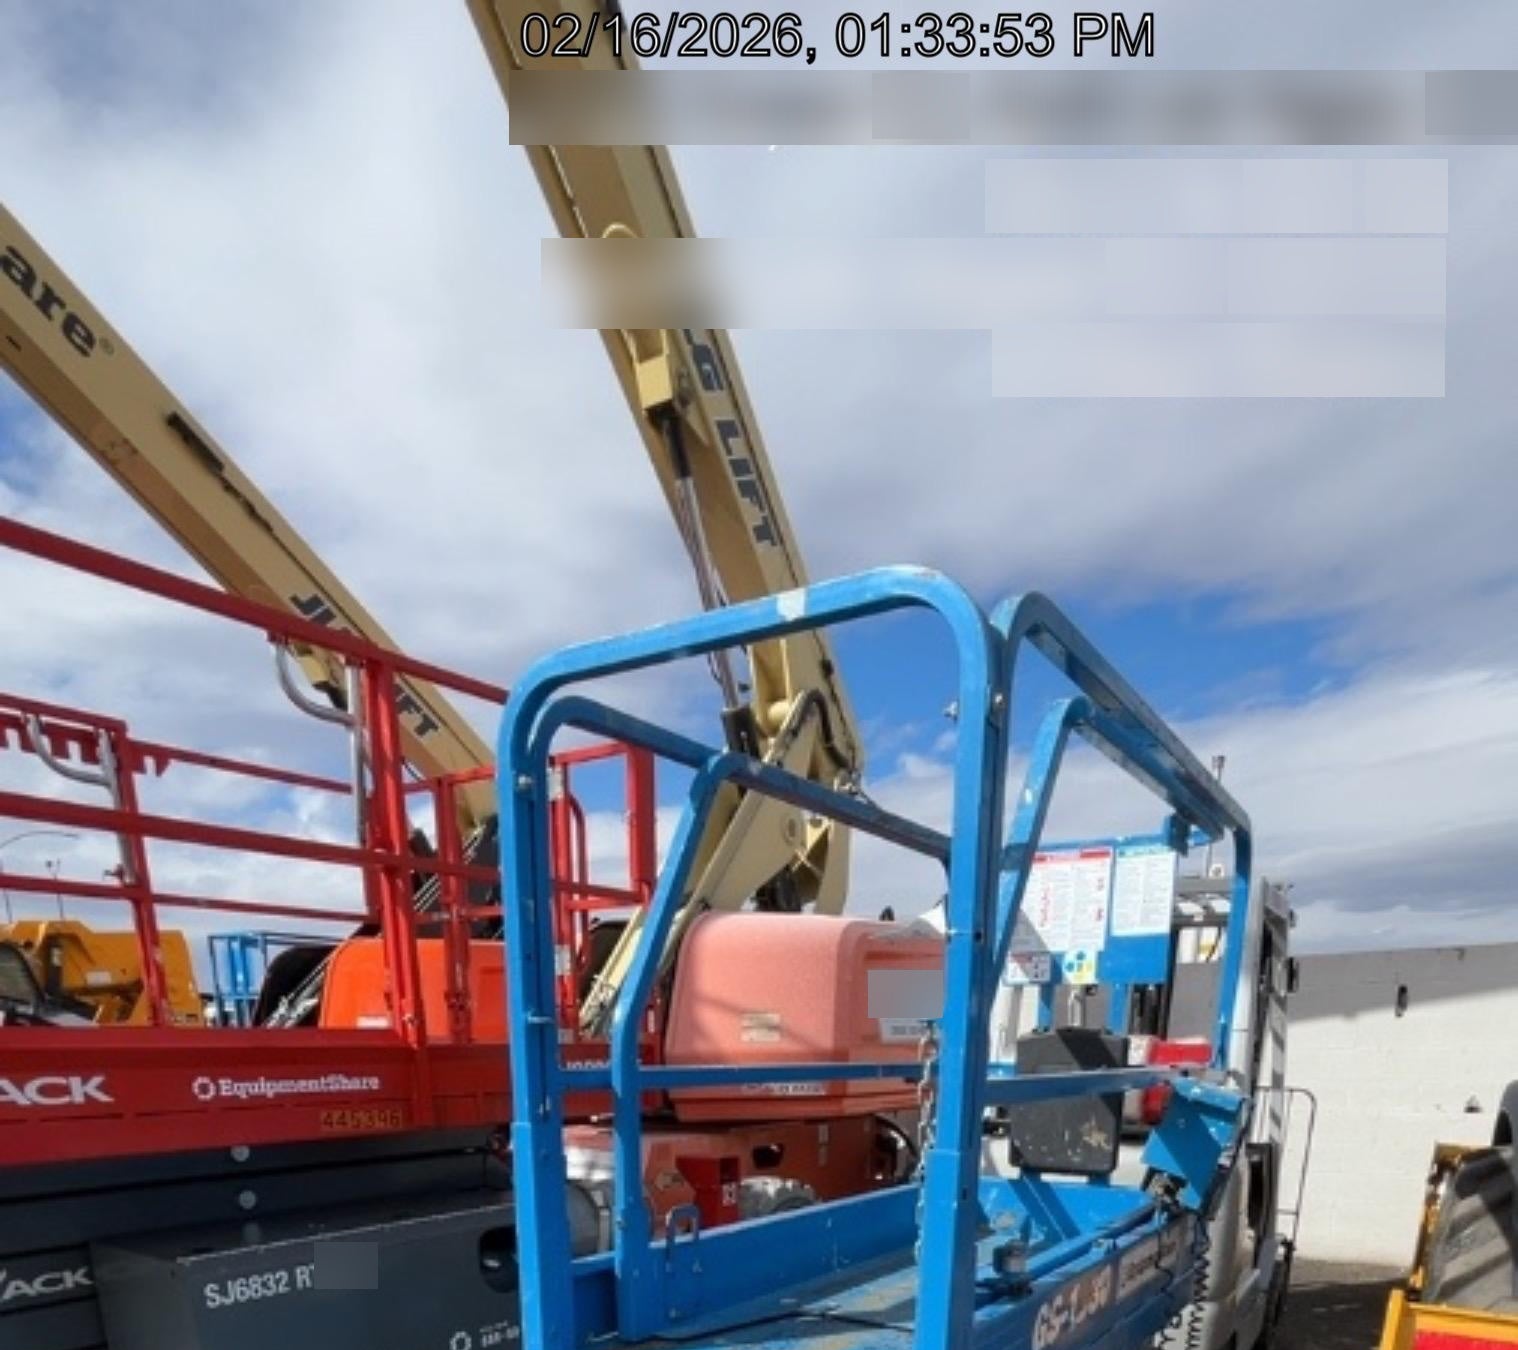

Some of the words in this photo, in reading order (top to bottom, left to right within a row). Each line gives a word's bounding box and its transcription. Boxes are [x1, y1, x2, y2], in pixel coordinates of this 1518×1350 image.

[715, 419, 779, 547] LIFT
[218, 1074, 380, 1099] EquipmentShare
[203, 1270, 291, 1309] SJ6832
